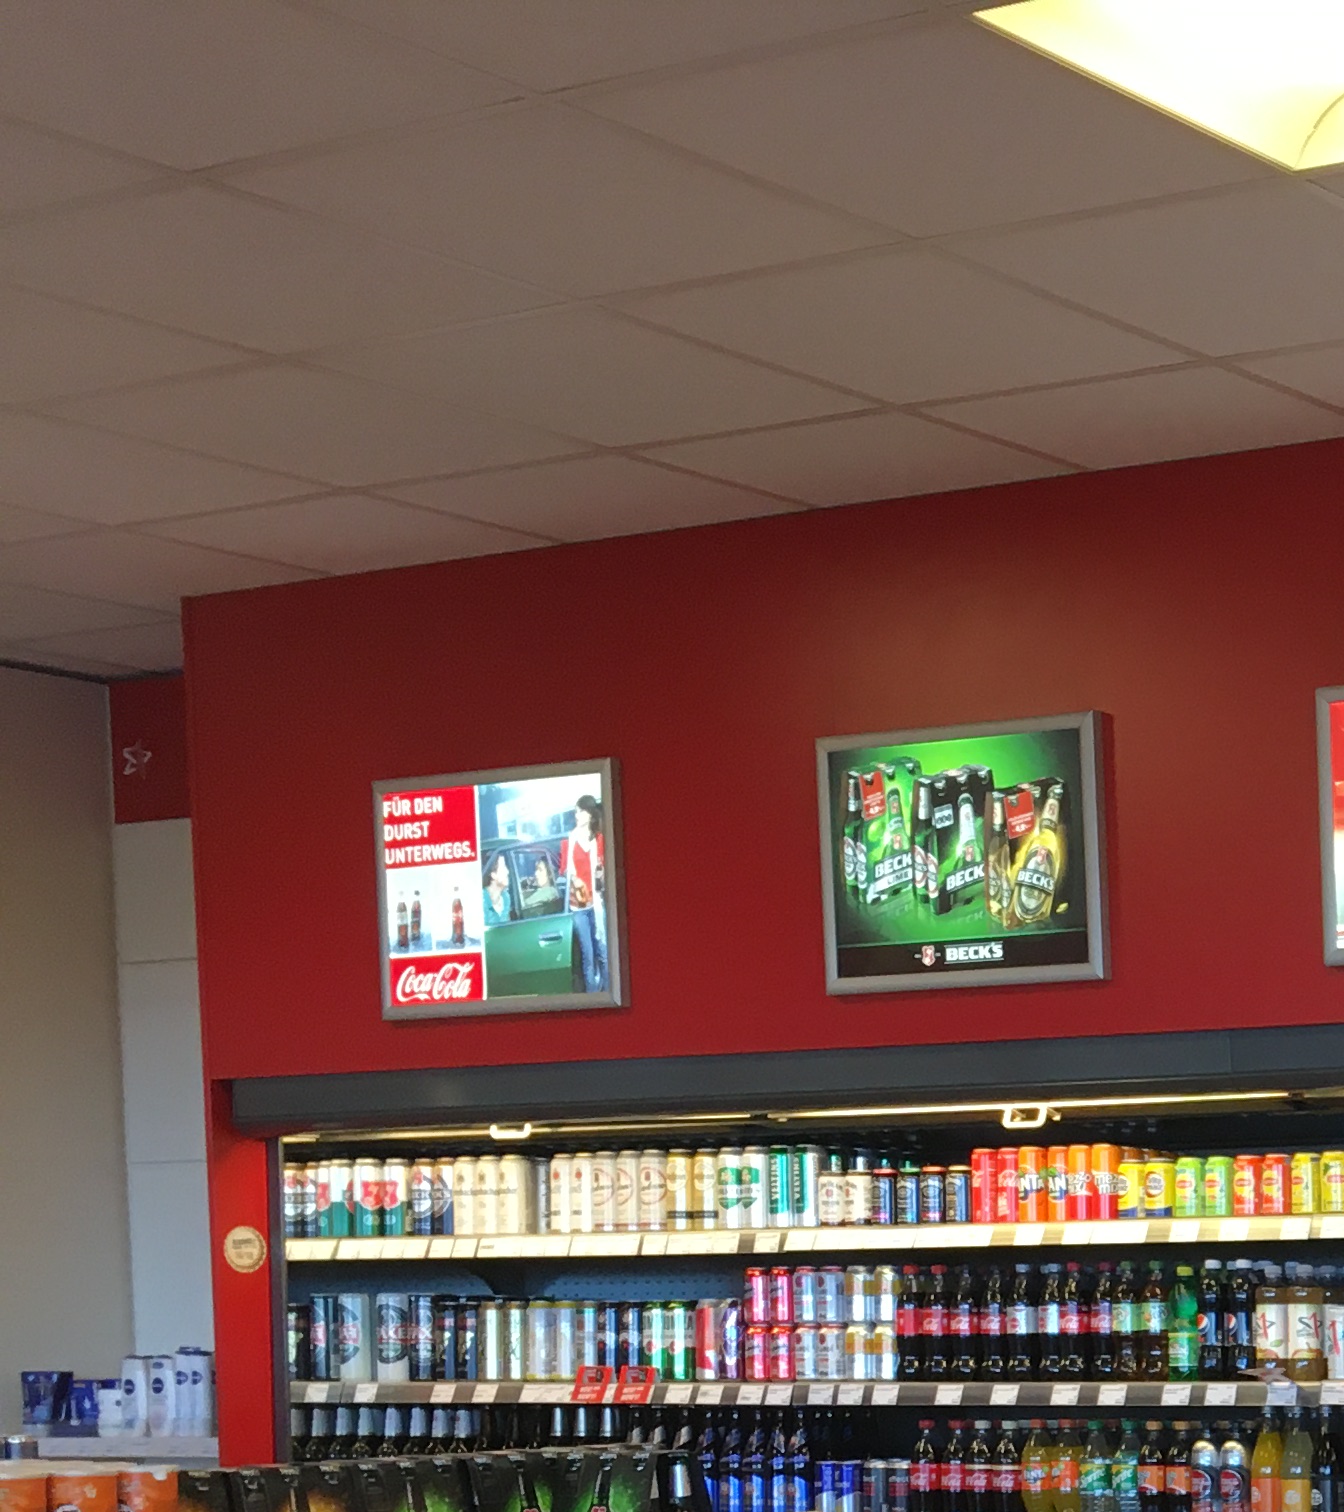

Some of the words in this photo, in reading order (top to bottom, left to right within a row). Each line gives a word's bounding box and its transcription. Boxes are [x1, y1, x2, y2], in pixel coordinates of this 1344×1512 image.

[382, 796, 412, 818] FÜR
[414, 796, 443, 815] DEN
[384, 821, 430, 842] DURST
[384, 841, 476, 865] UNTERWEGS.
[945, 941, 1004, 962] BECK'S
[396, 962, 476, 1003] Coca-Cola
